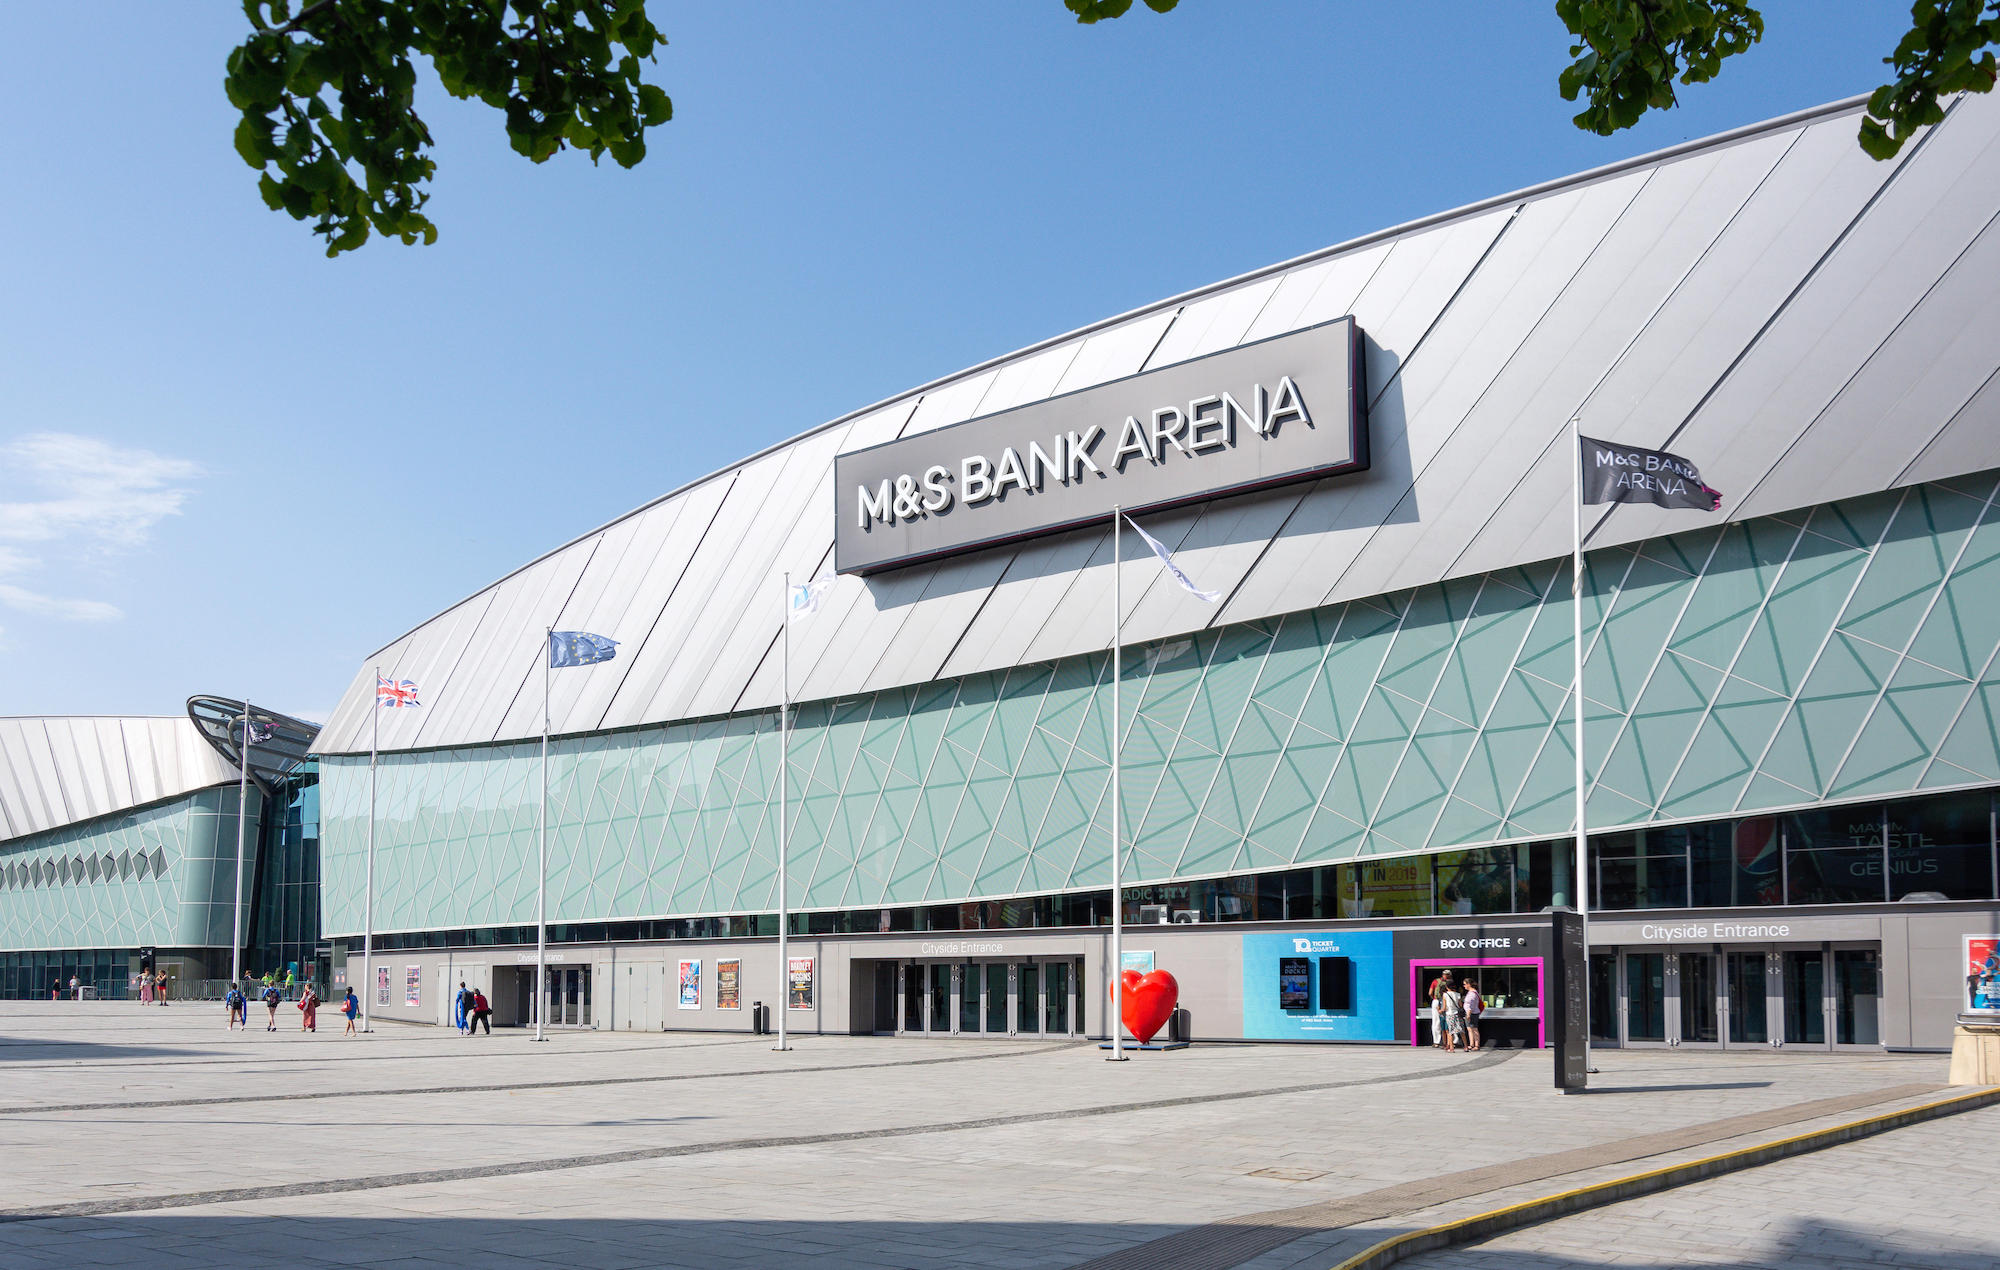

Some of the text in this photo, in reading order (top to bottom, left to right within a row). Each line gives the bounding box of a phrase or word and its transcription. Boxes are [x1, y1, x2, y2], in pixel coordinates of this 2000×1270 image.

[857, 375, 1313, 530] M&S BANK ARENA
[1595, 450, 1641, 468] M&S
[1616, 471, 1688, 496] ARENA
[1849, 832, 1937, 850] TASTE
[1346, 867, 1418, 883] DY IN 2019
[1849, 858, 1938, 877] GENIUS
[1122, 886, 1189, 902] ADIO ITY
[1641, 923, 1790, 942] Cityside Entrance
[921, 941, 1003, 955] Cityside Entrance
[1440, 937, 1511, 949] BOX OFFICE
